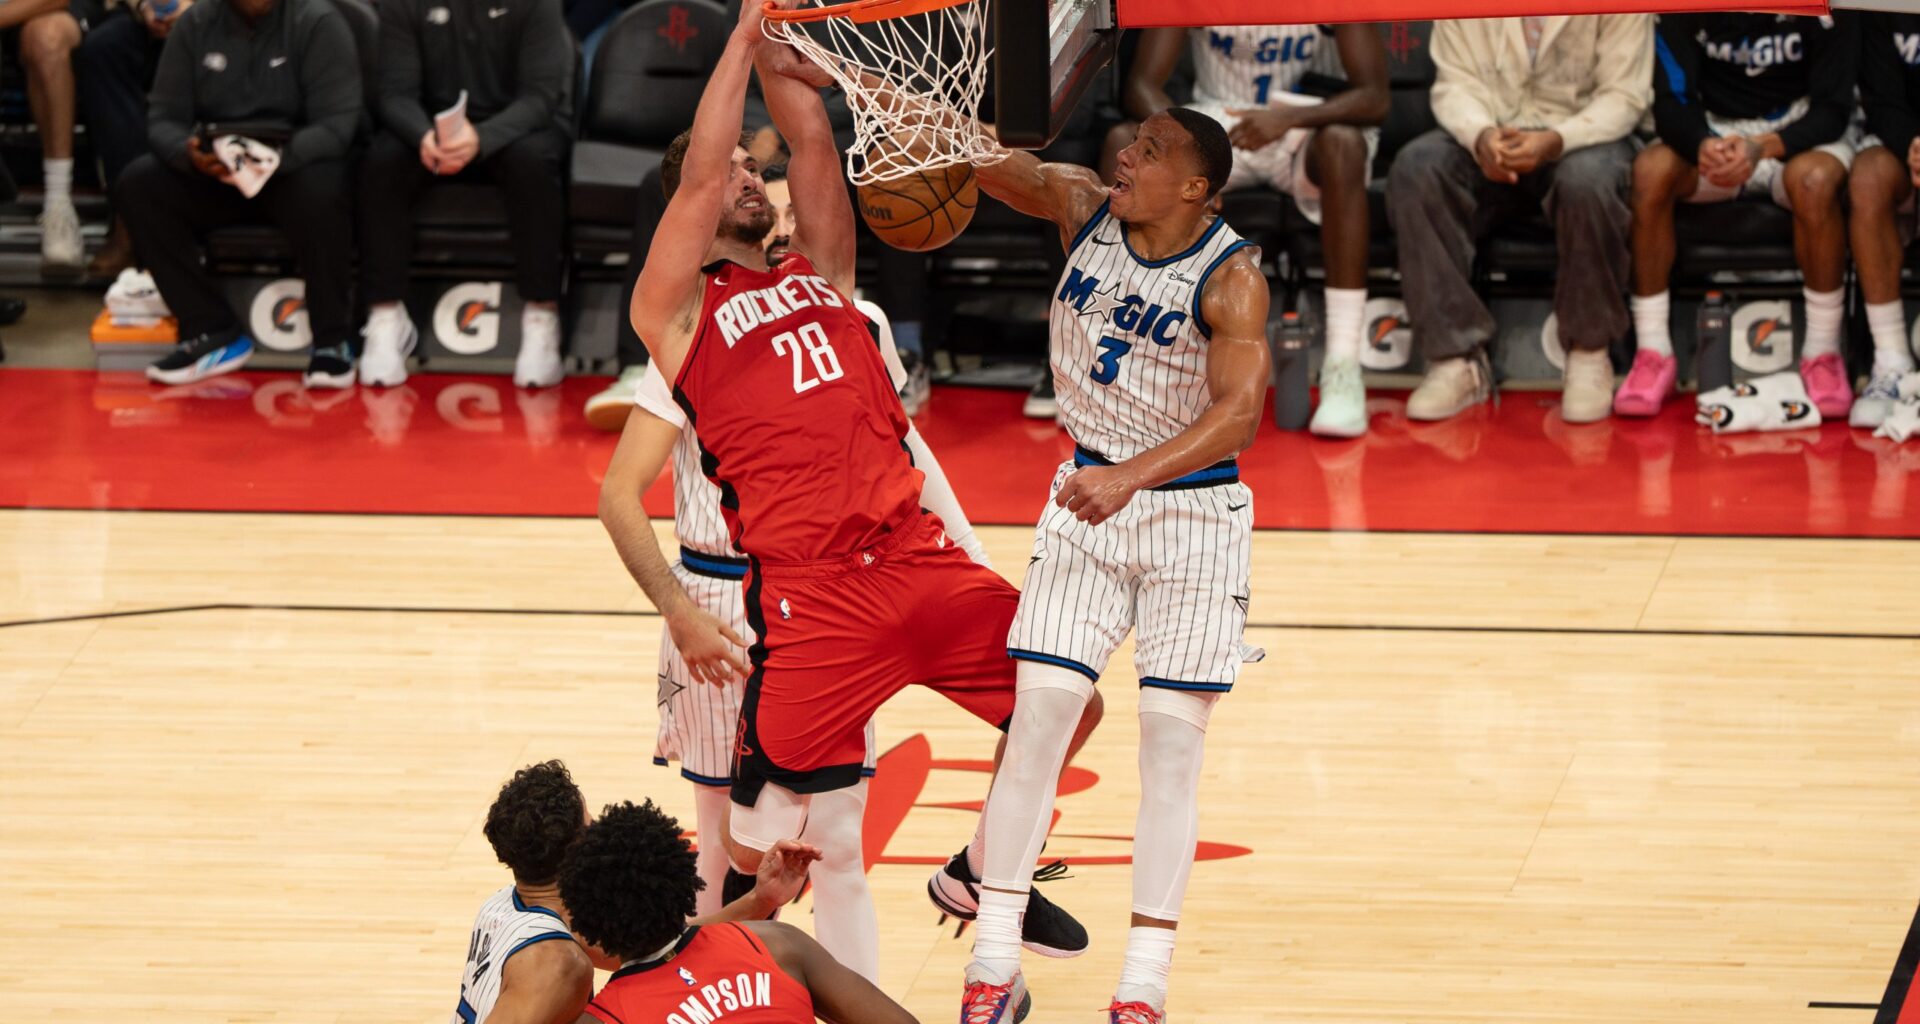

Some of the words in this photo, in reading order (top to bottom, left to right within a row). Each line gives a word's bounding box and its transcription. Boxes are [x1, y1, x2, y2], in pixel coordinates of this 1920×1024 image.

[1253, 74, 1272, 105] 1
[713, 274, 844, 350] ROCKETS
[1166, 267, 1197, 289] Disney
[433, 282, 502, 355] G
[1730, 299, 1793, 374] G
[770, 321, 845, 394] 28
[1089, 335, 1133, 386] 3
